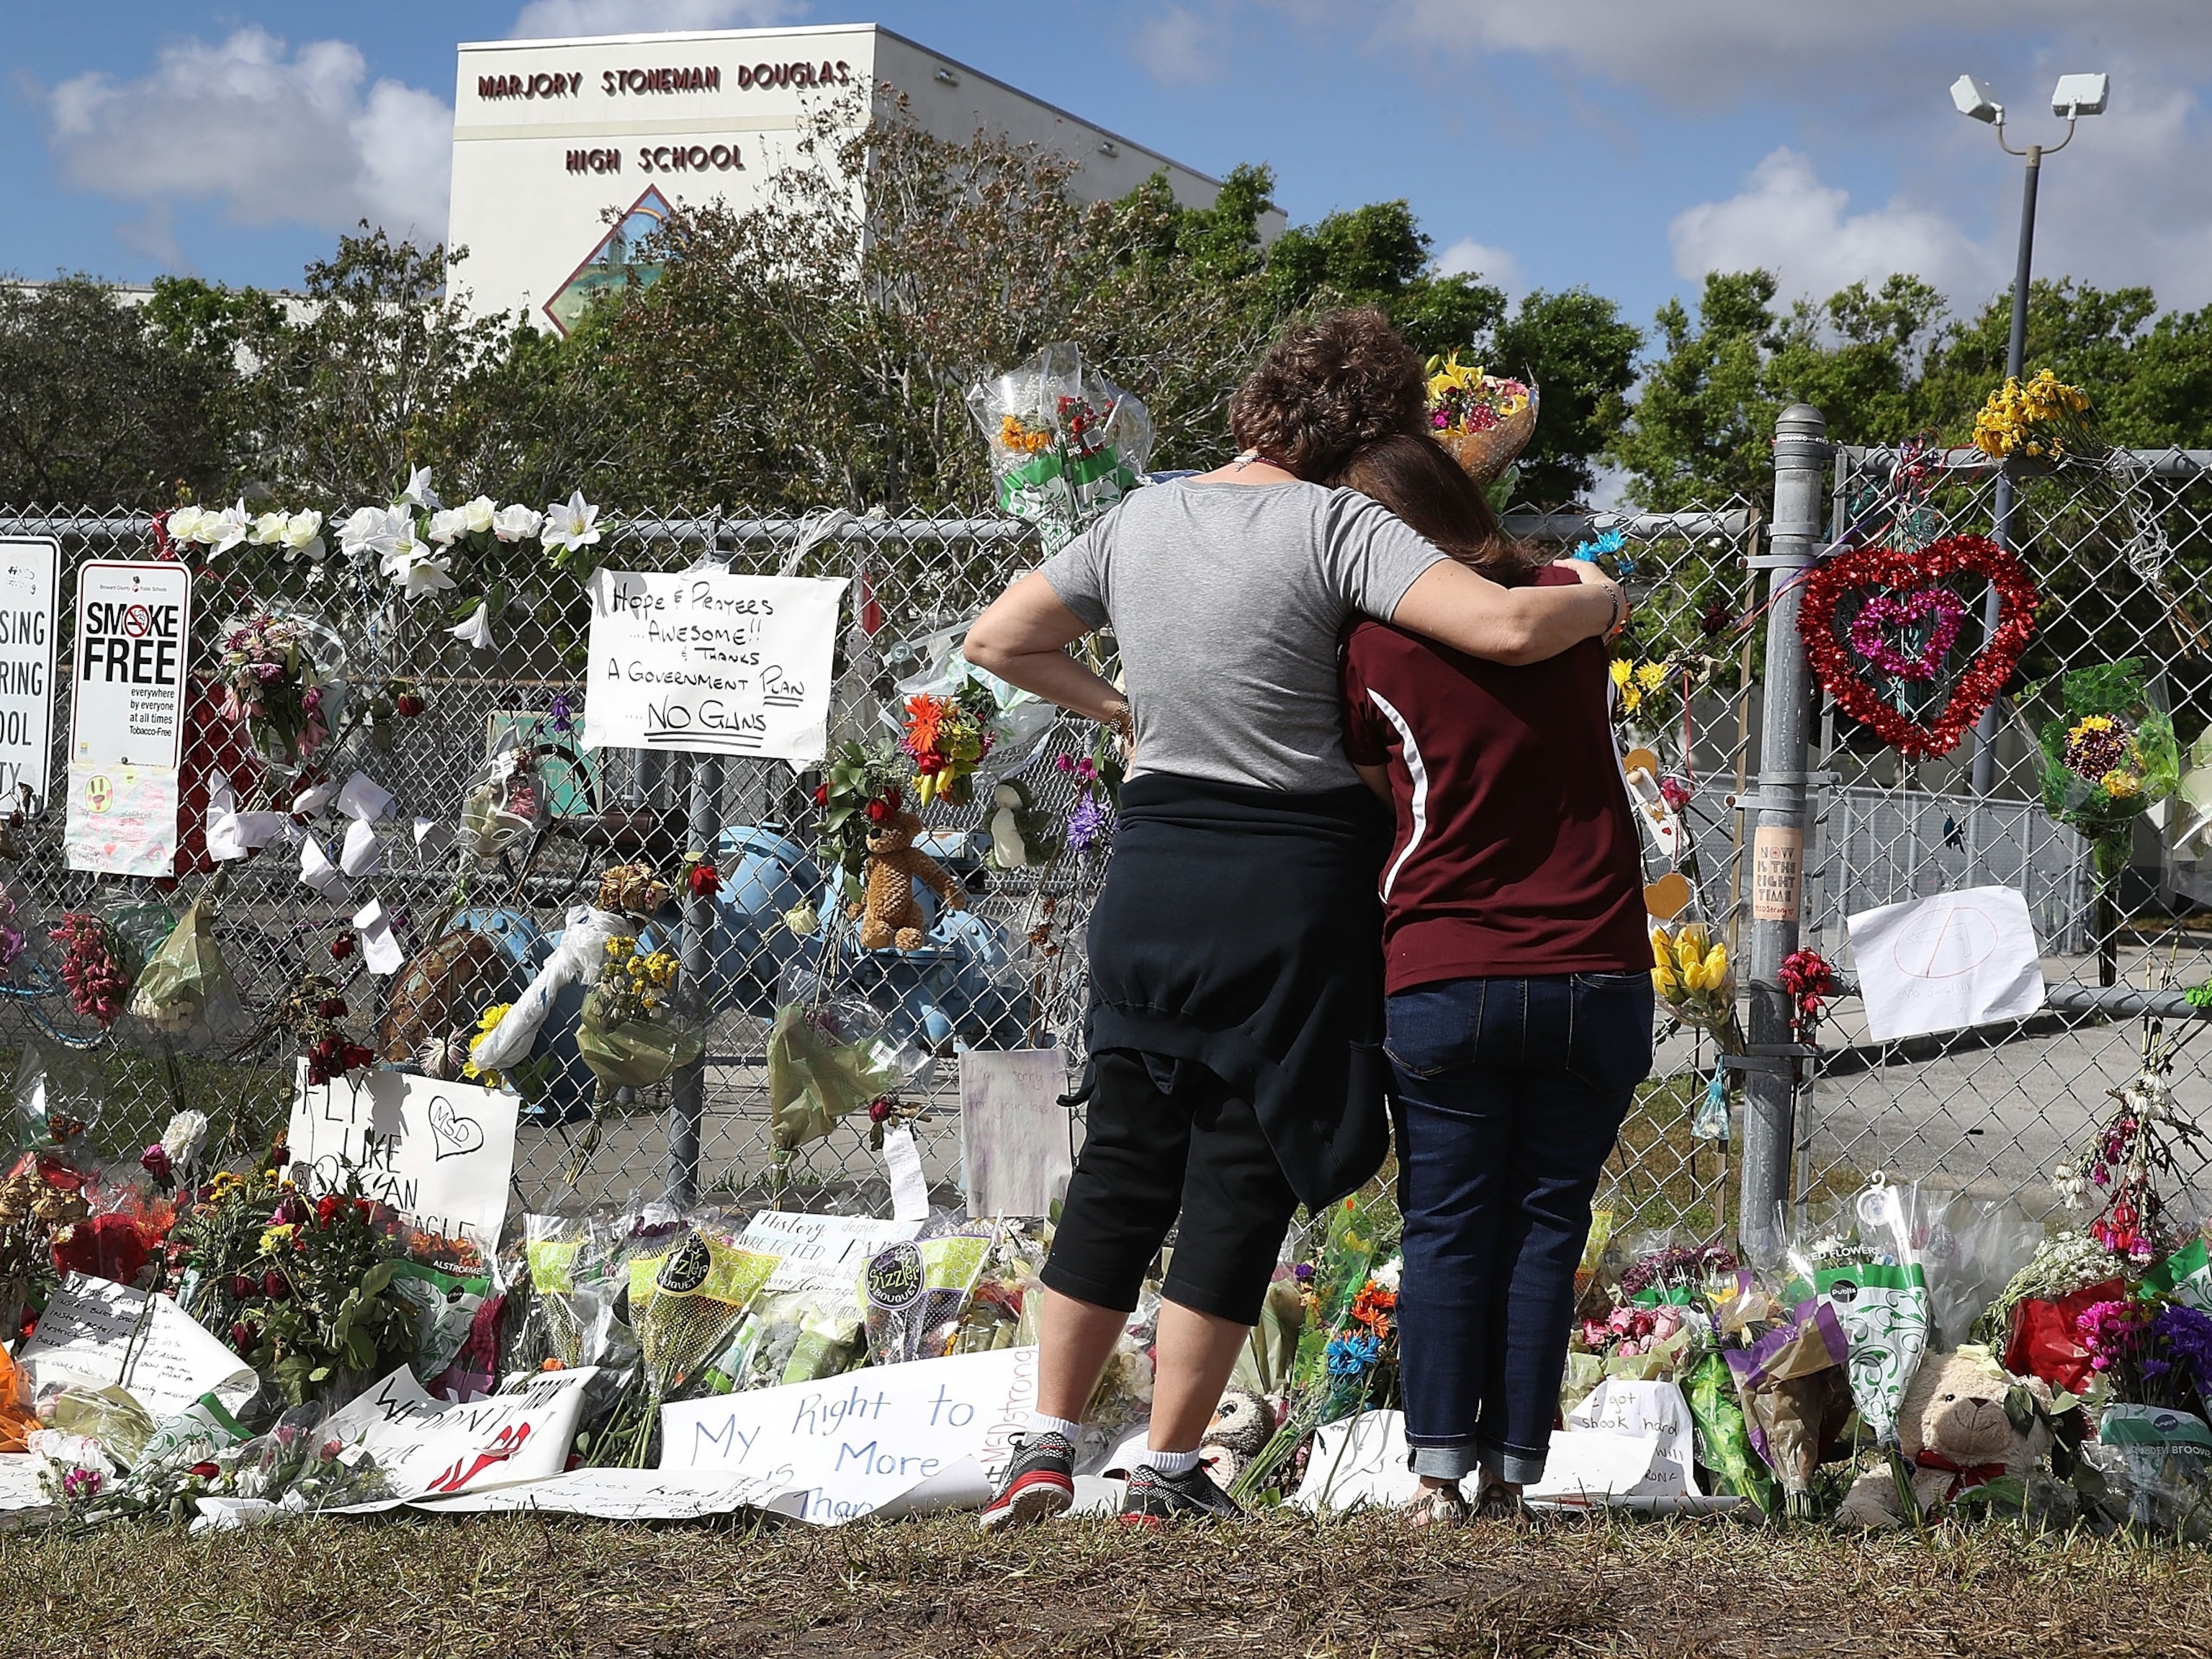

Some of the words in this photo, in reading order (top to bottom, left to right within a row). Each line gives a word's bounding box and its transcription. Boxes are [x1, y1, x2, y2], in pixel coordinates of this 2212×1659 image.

[478, 71, 582, 99] MARJORY
[601, 66, 719, 94] STONEMAN
[738, 60, 850, 88] DOUGLAS
[566, 148, 621, 173] HIGH
[638, 144, 745, 172] SCHOOL
[613, 583, 665, 619] Hope
[86, 601, 179, 638] SMOKE
[84, 637, 177, 685] FREE
[693, 647, 760, 665] THANKS
[607, 657, 620, 680] A
[628, 660, 749, 691] GOVERNMENT
[759, 665, 805, 696] PLAN
[130, 688, 175, 700] everywhere
[130, 700, 139, 711] by
[140, 701, 174, 712] everyone
[698, 699, 767, 732] GUNS
[129, 713, 137, 723] at
[138, 714, 150, 724] all
[151, 714, 173, 725] times
[129, 725, 172, 737] Tobacco-Free
[1761, 846, 1794, 860] NOW
[1771, 860, 1796, 873] THE
[1757, 875, 1796, 888] RIGHT
[1759, 889, 1791, 902] TIME
[1012, 1070, 1044, 1091] sorry
[996, 1101, 1022, 1119] your
[433, 1105, 470, 1143] MSD
[383, 1177, 418, 1210] AN
[1830, 1246, 1881, 1258] FLOWERS
[84, 1287, 110, 1299] more
[873, 1281, 917, 1303] BOUQUET
[1831, 1287, 1857, 1296] Publix
[42, 1322, 80, 1339] Restrict
[49, 1309, 81, 1323] Install
[85, 1321, 114, 1334] metal
[374, 1375, 425, 1425] WE
[1609, 1392, 1637, 1414] got
[691, 1413, 760, 1466] My
[791, 1386, 891, 1437] Right
[927, 1384, 974, 1427] to
[1581, 1416, 1629, 1430] shook
[1642, 1417, 1678, 1437] hard
[835, 1441, 939, 1477] More
